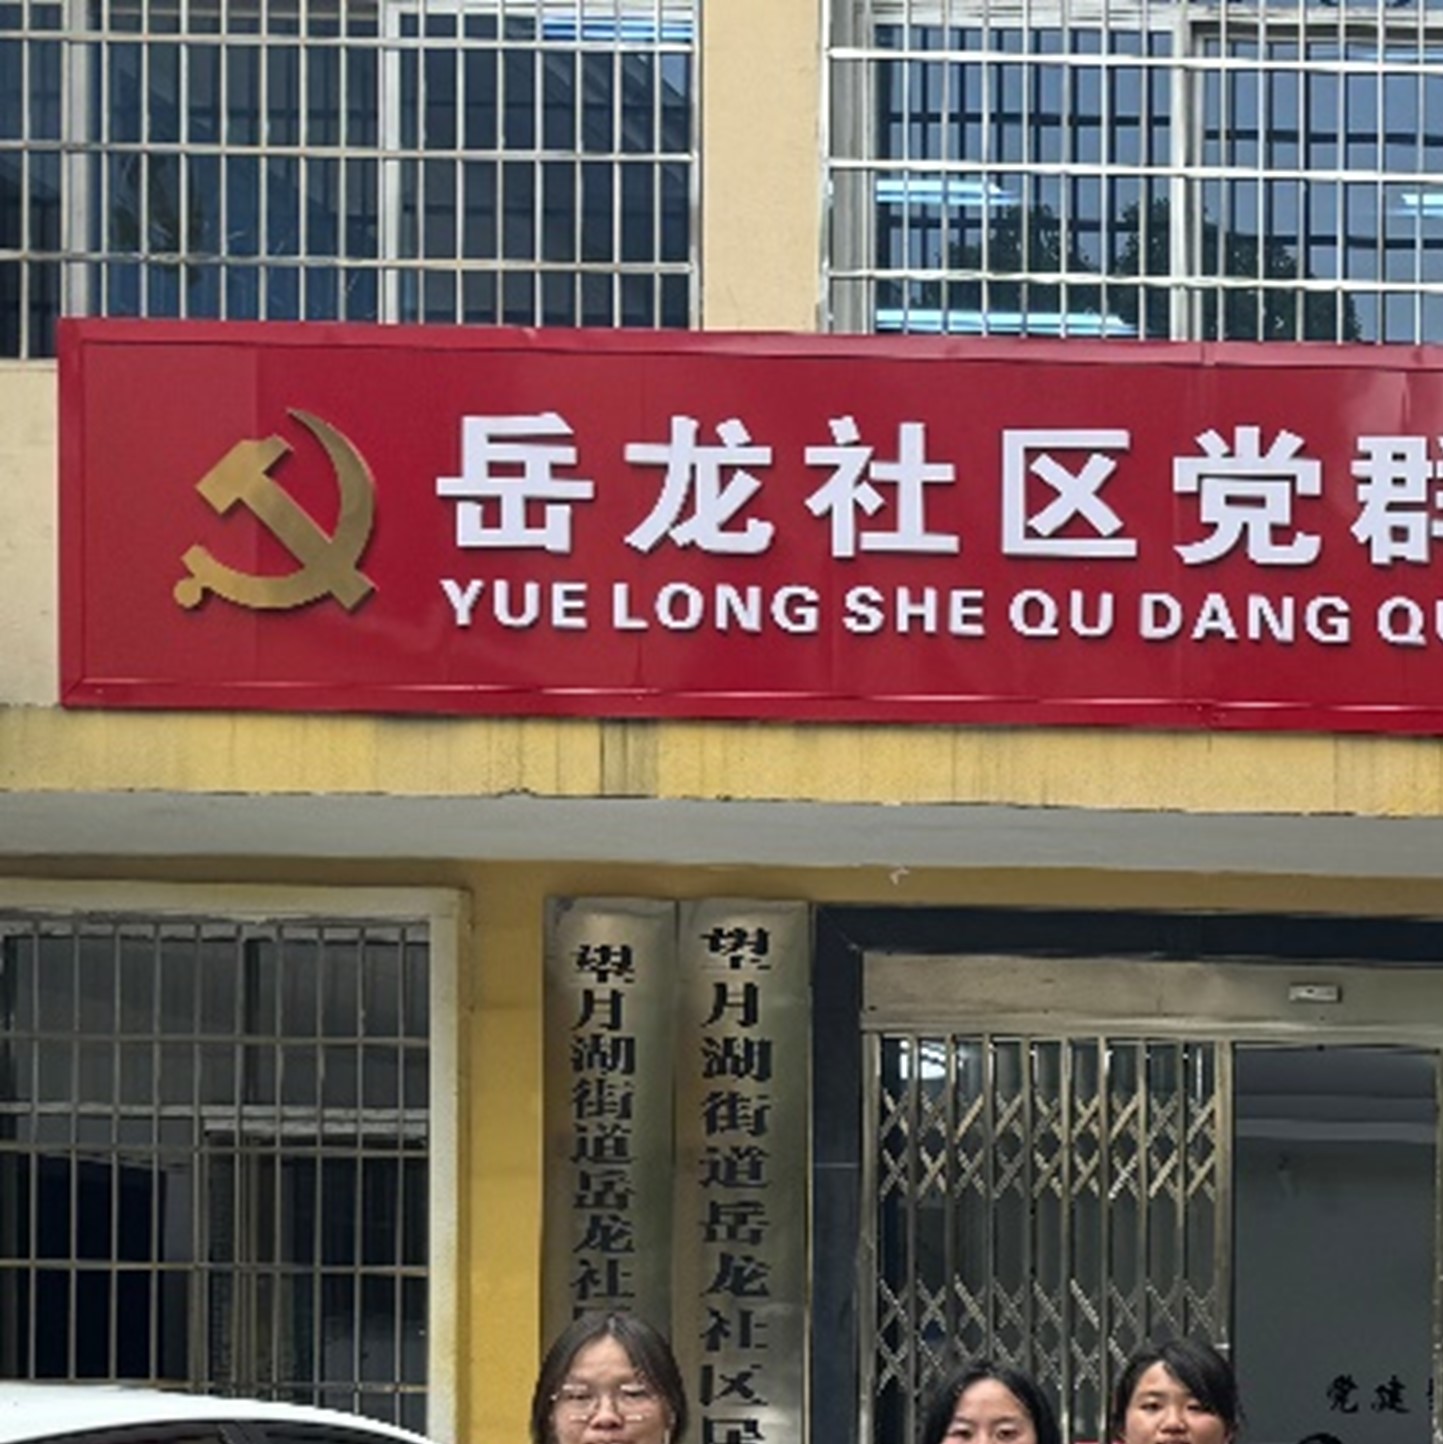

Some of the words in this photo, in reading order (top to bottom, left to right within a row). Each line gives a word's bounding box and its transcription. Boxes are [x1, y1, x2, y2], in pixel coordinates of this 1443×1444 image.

[442, 579, 587, 629] YUE
[613, 583, 819, 633] LONG
[843, 587, 984, 635] SHE
[1009, 590, 1113, 637] QU
[1140, 593, 1349, 642] DANG
[569, 942, 637, 1322] 望月湖街道岳龙社
[1326, 1374, 1434, 1414] 党建
